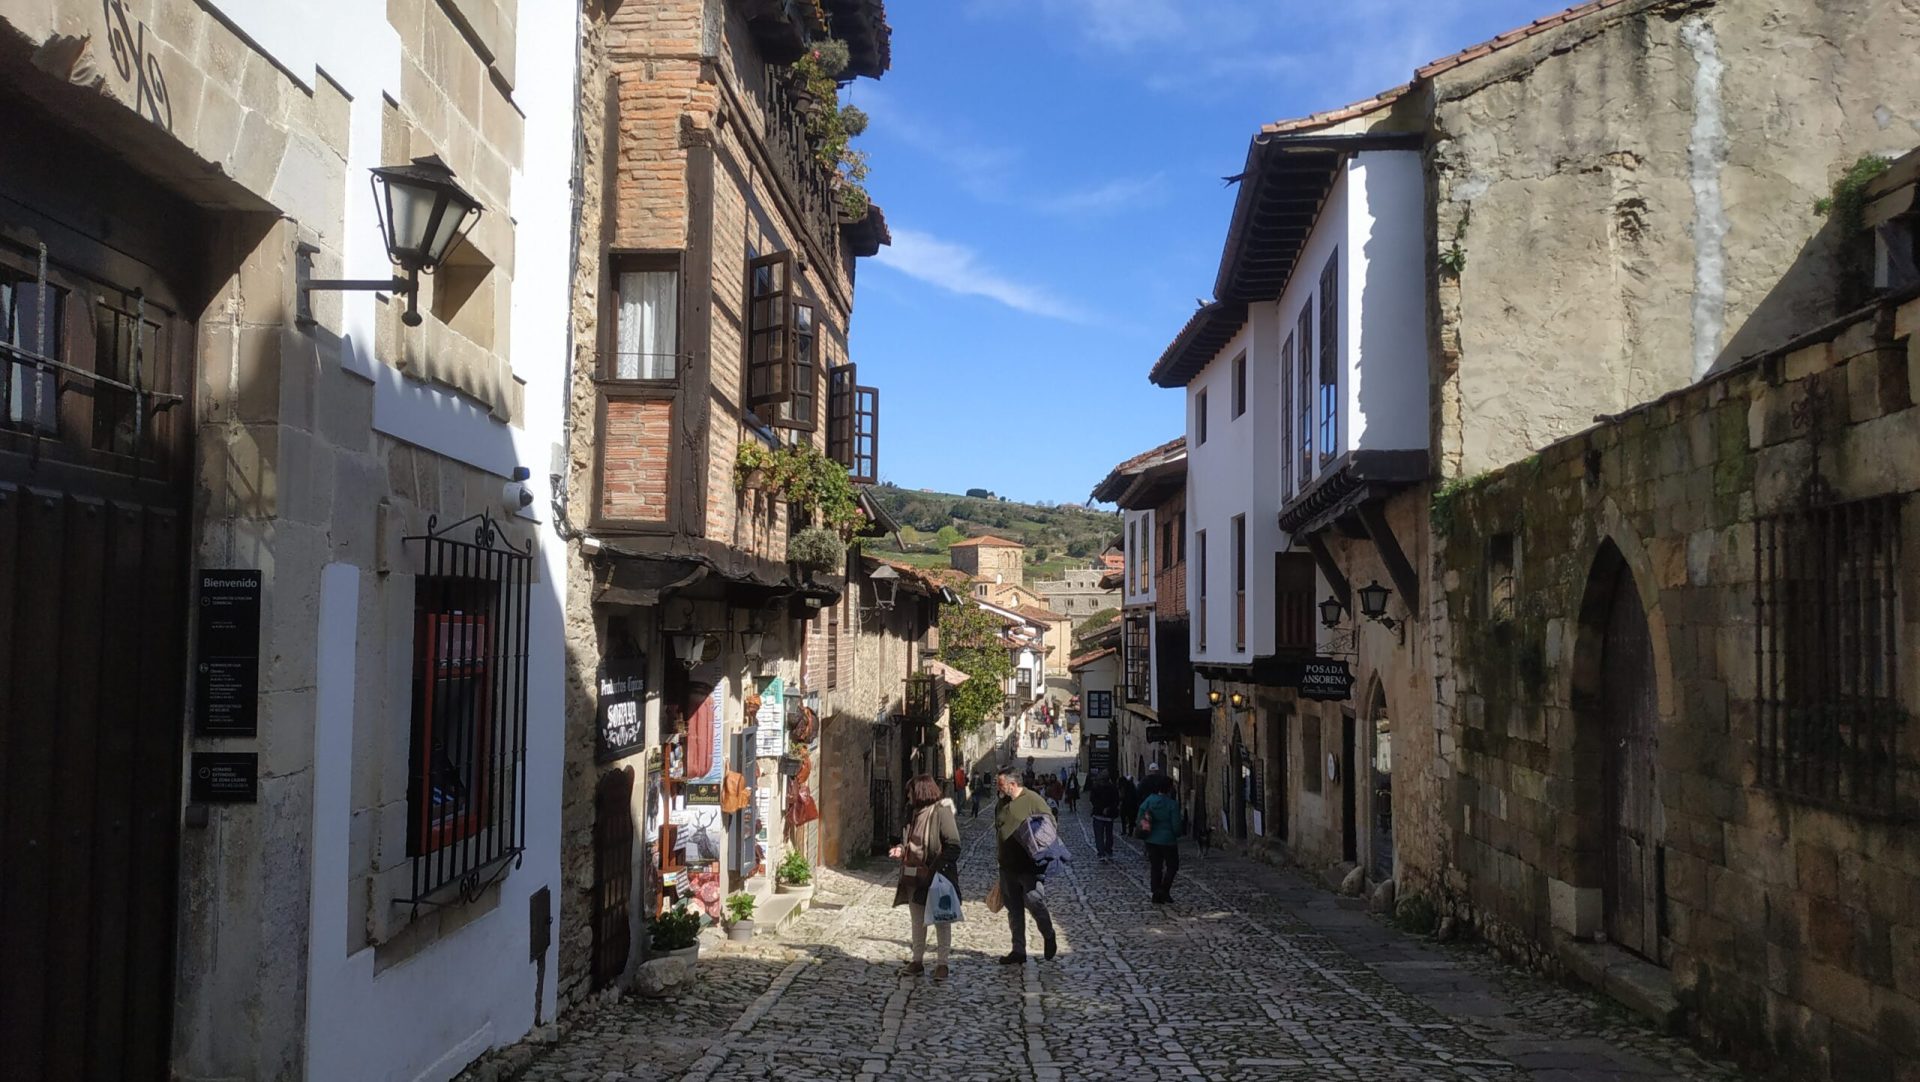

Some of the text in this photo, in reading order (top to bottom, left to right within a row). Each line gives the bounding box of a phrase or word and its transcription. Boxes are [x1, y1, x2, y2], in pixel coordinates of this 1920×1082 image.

[203, 577, 258, 588] Bienvenido
[1305, 664, 1344, 674] POSADA
[1302, 674, 1347, 685] ANSORENA
[600, 676, 626, 697] Productos
[711, 715, 722, 729] de
